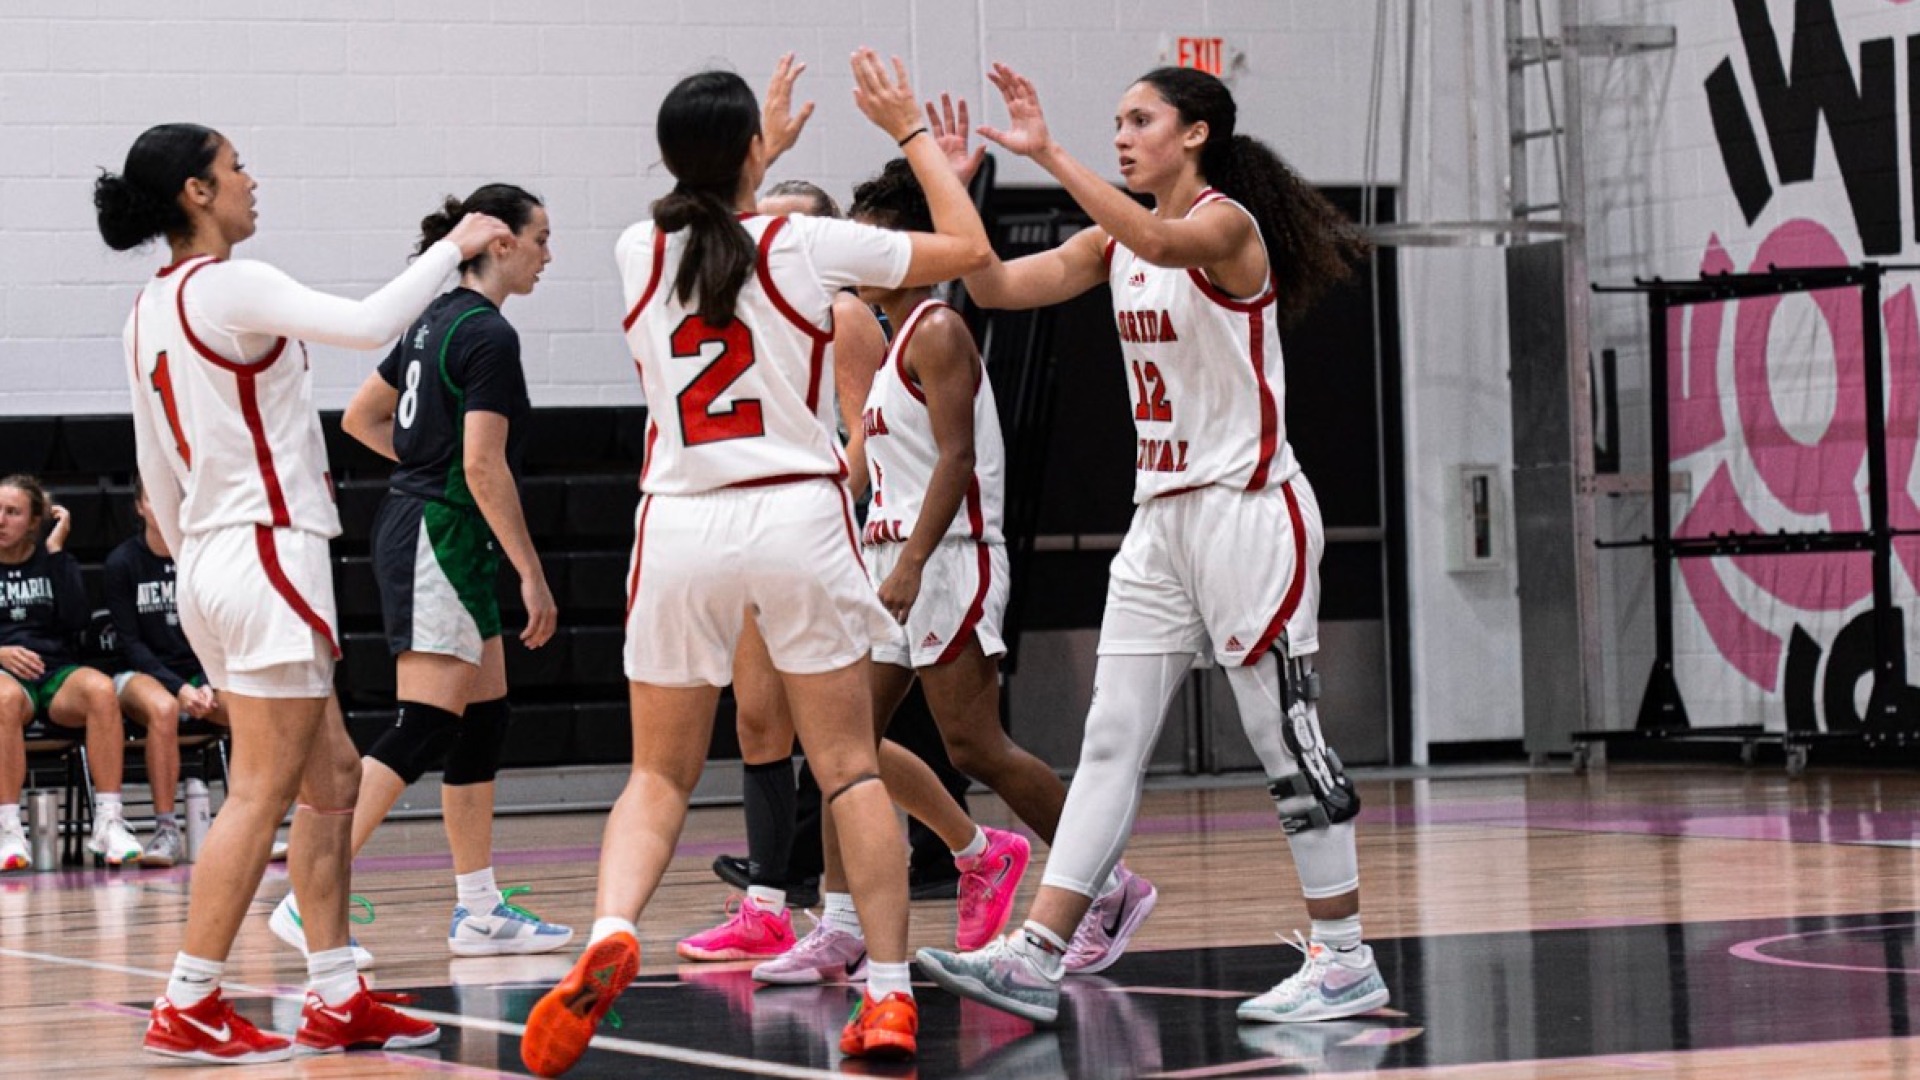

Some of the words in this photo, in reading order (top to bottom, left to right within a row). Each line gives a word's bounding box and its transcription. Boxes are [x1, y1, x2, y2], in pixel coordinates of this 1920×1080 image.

[1177, 37, 1223, 76] EXIT
[149, 349, 192, 472] 1
[399, 359, 421, 429] 8
[671, 313, 765, 448] 2
[1132, 359, 1173, 422] 12
[6, 577, 53, 600] MARIA
